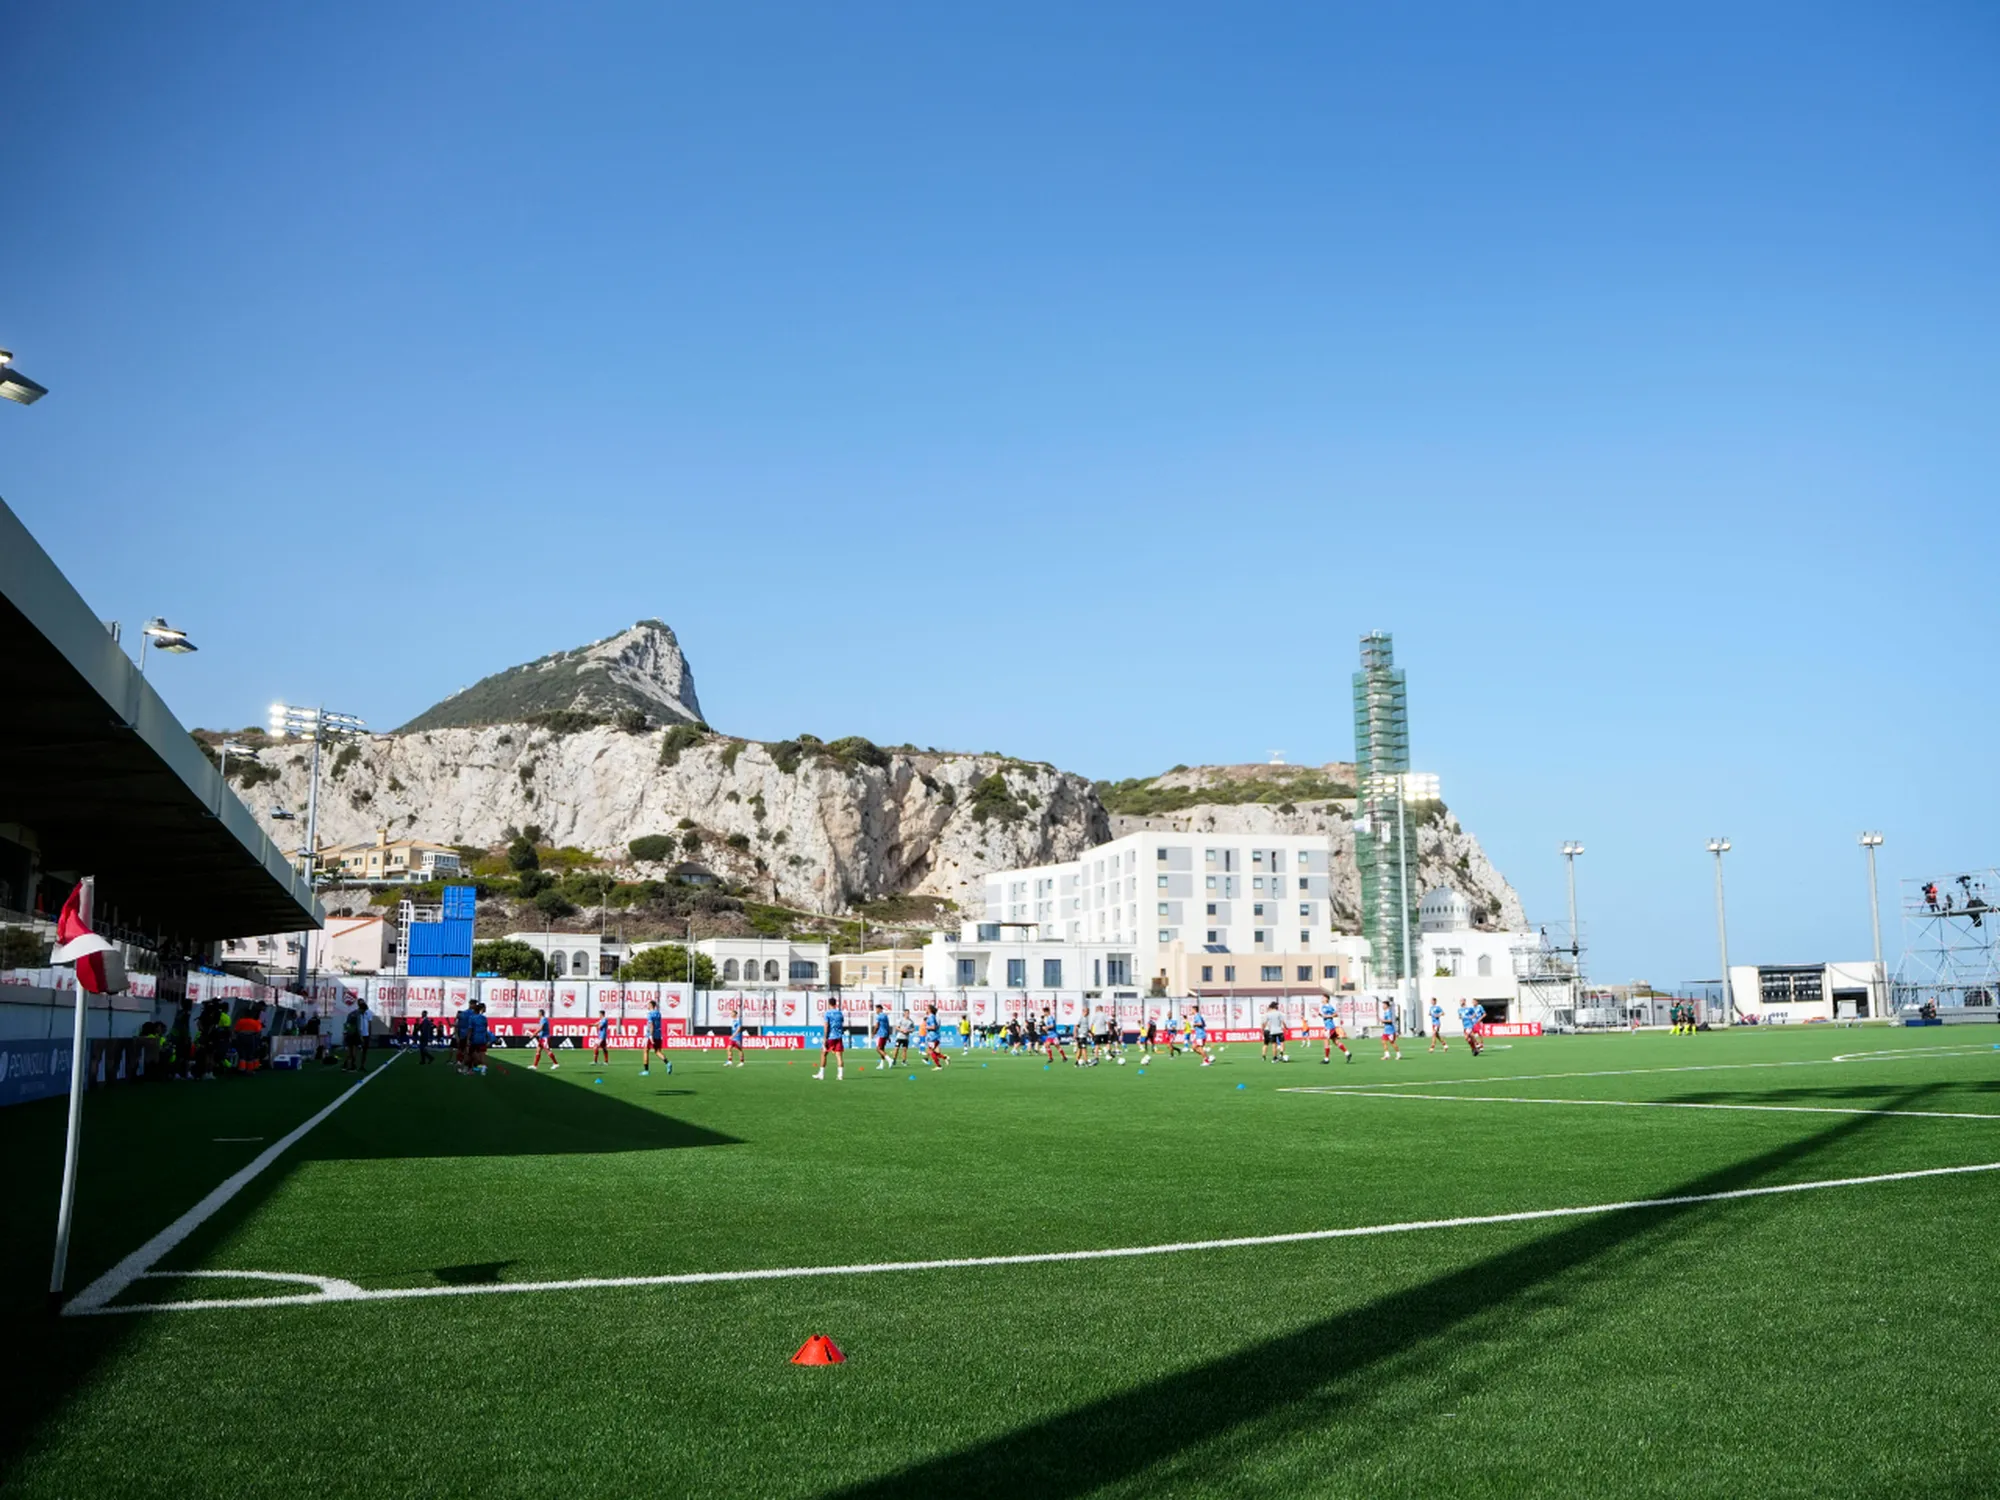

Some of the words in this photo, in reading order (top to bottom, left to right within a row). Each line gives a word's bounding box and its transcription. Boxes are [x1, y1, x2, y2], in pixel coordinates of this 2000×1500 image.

[378, 987, 445, 1001] GIBRALTAR
[490, 988, 555, 1002] GIBRALTAR
[599, 990, 661, 1003] GIBRALTAR
[717, 998, 777, 1011] GIBRALTAR
[816, 999, 874, 1012] GIRALTAR
[1179, 1004, 1227, 1016] GIBALTAR
[552, 1025, 638, 1037] GIBRATAR
[588, 1037, 635, 1048] GRALTAR
[667, 1037, 712, 1048] GIBRALTAR
[713, 1037, 725, 1048] FA
[742, 1037, 786, 1048] GIBRALTAR
[787, 1037, 798, 1048] FA
